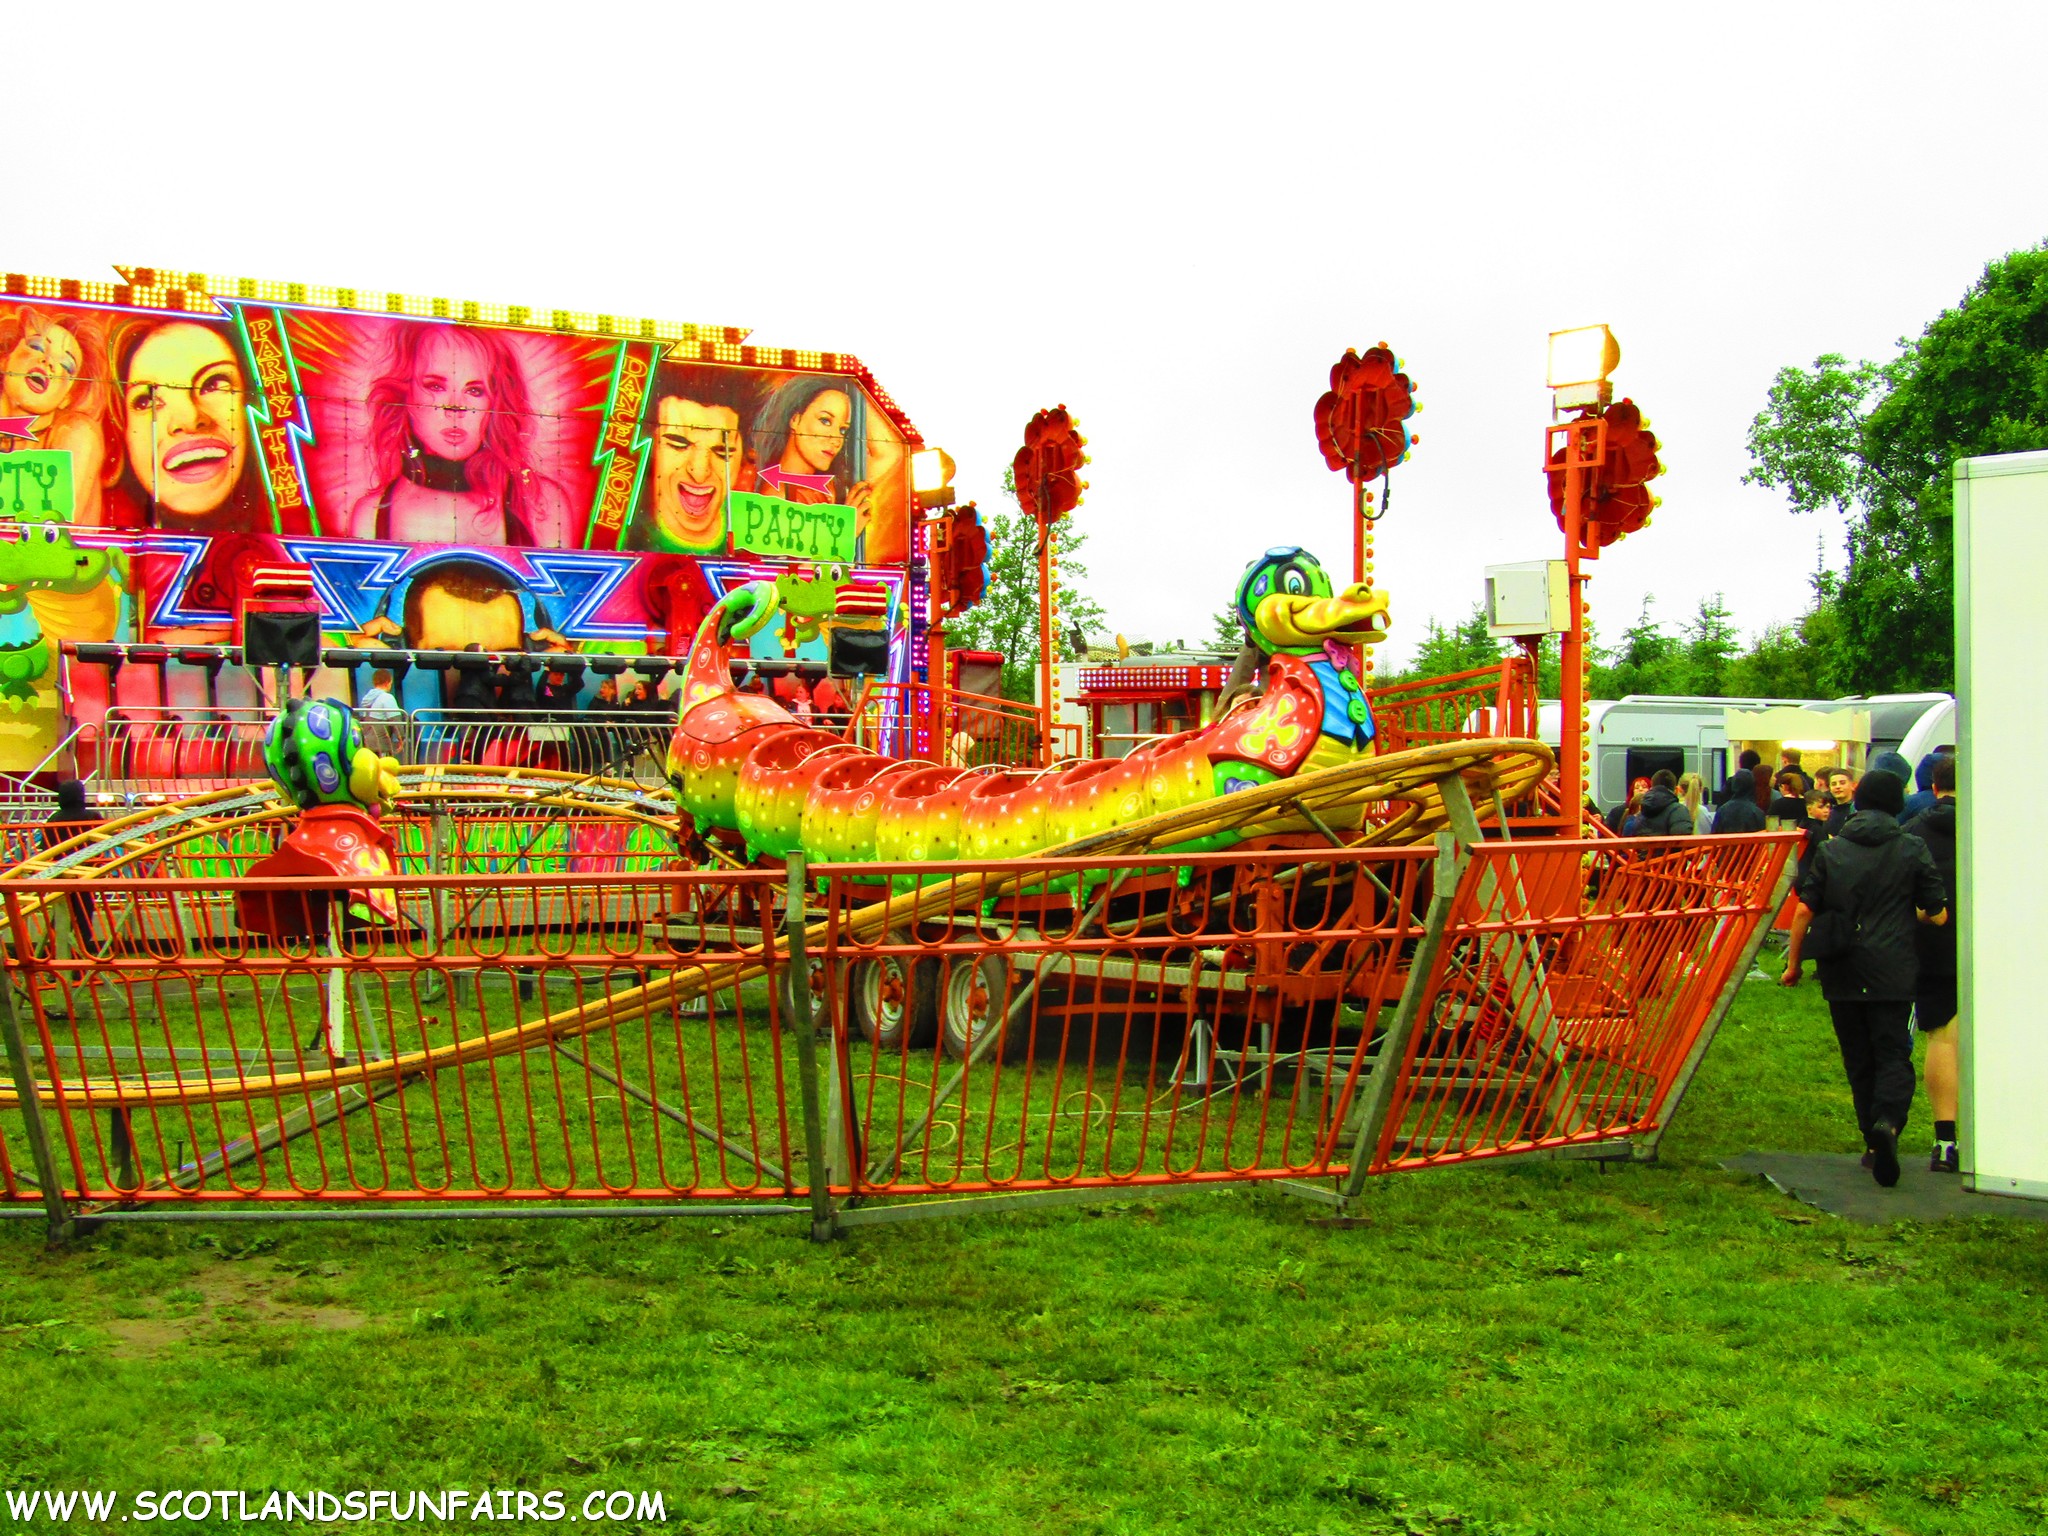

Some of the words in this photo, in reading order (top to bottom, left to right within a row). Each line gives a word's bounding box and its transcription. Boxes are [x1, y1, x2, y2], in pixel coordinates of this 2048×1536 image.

[250, 319, 293, 418] PARTY
[606, 355, 648, 447] DANCE
[0, 461, 58, 513] TY
[263, 427, 301, 508] TIME
[597, 455, 636, 529] ZONE
[745, 501, 845, 556] PARTY
